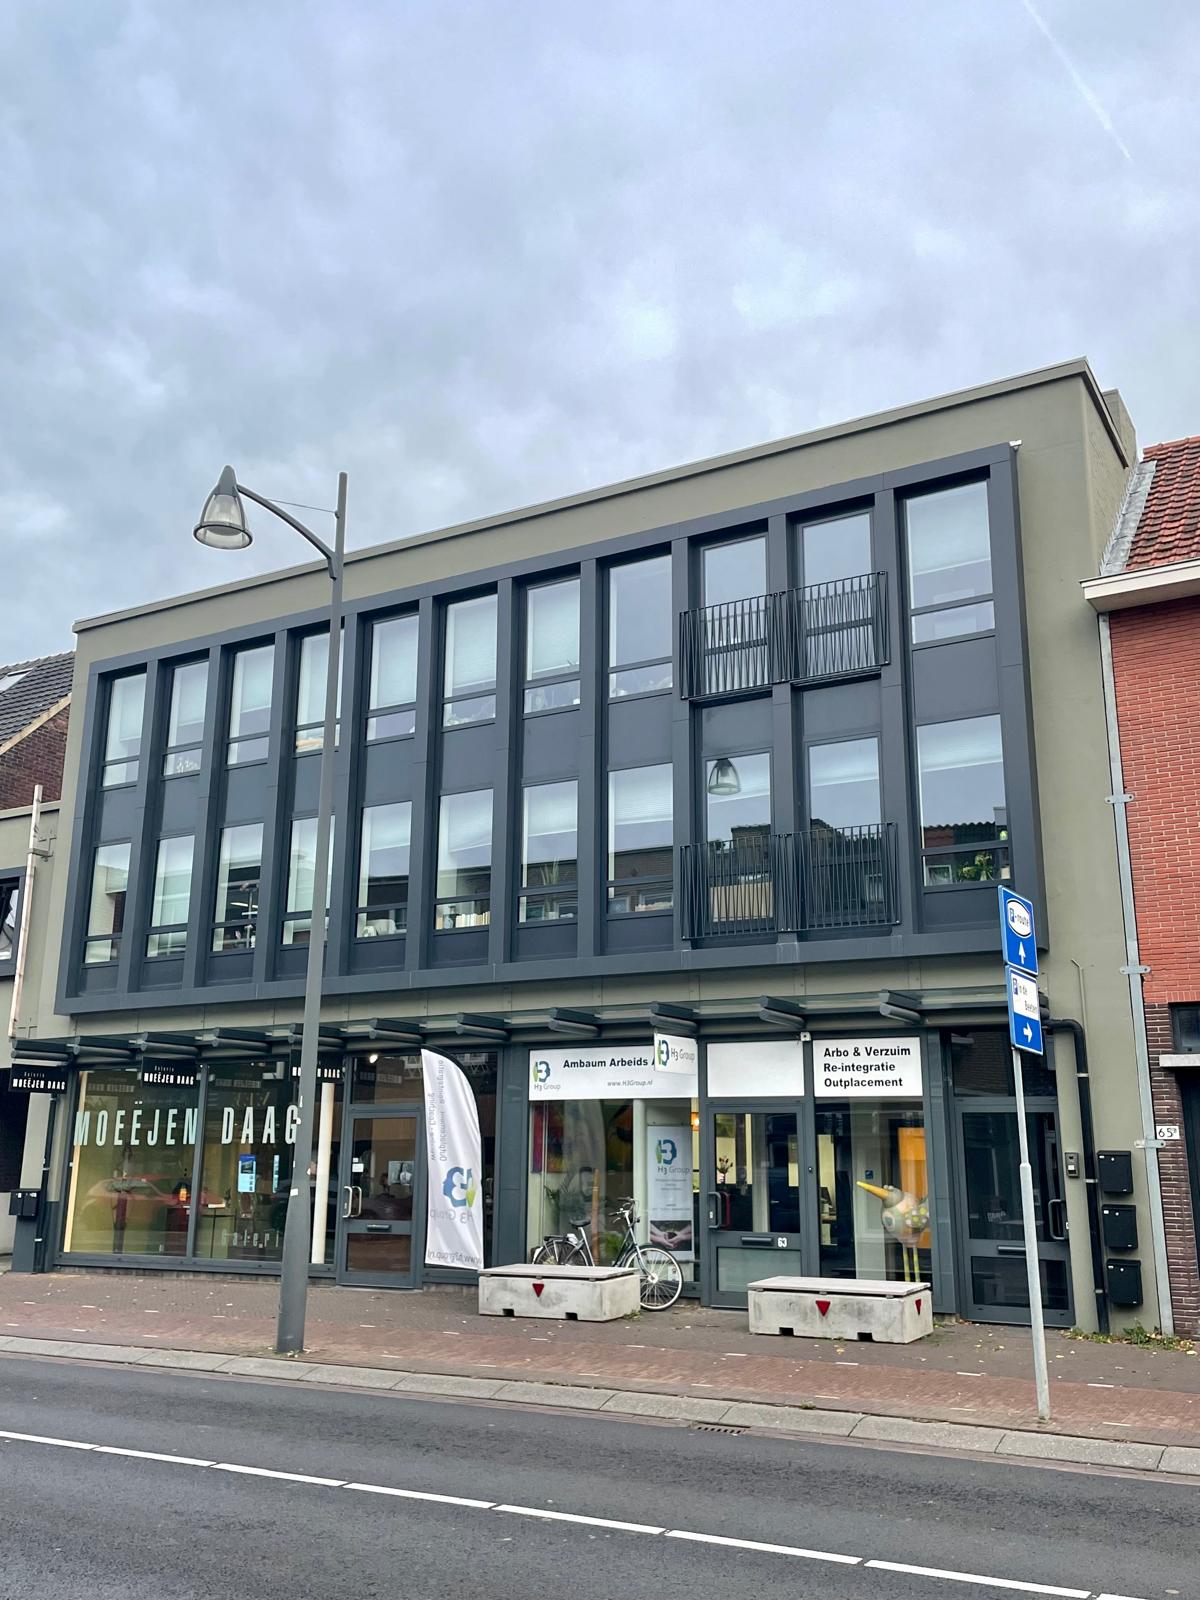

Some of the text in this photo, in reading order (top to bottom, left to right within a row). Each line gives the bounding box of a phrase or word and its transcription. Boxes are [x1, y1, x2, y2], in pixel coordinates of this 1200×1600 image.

[823, 1046, 911, 1057] Arbo & Verzuim
[563, 1059, 606, 1069] Ambaum
[609, 1057, 649, 1067] Arbeids
[823, 1062, 896, 1074] Re-integratie
[47, 1080, 66, 1091] DAAG
[176, 1075, 195, 1086] DAAG
[824, 1077, 903, 1090] Outplacement
[543, 1083, 561, 1091] Group
[73, 1100, 299, 1146] MOEËJEN DAAG
[669, 1166, 690, 1175] Group
[777, 1237, 788, 1248] 63
